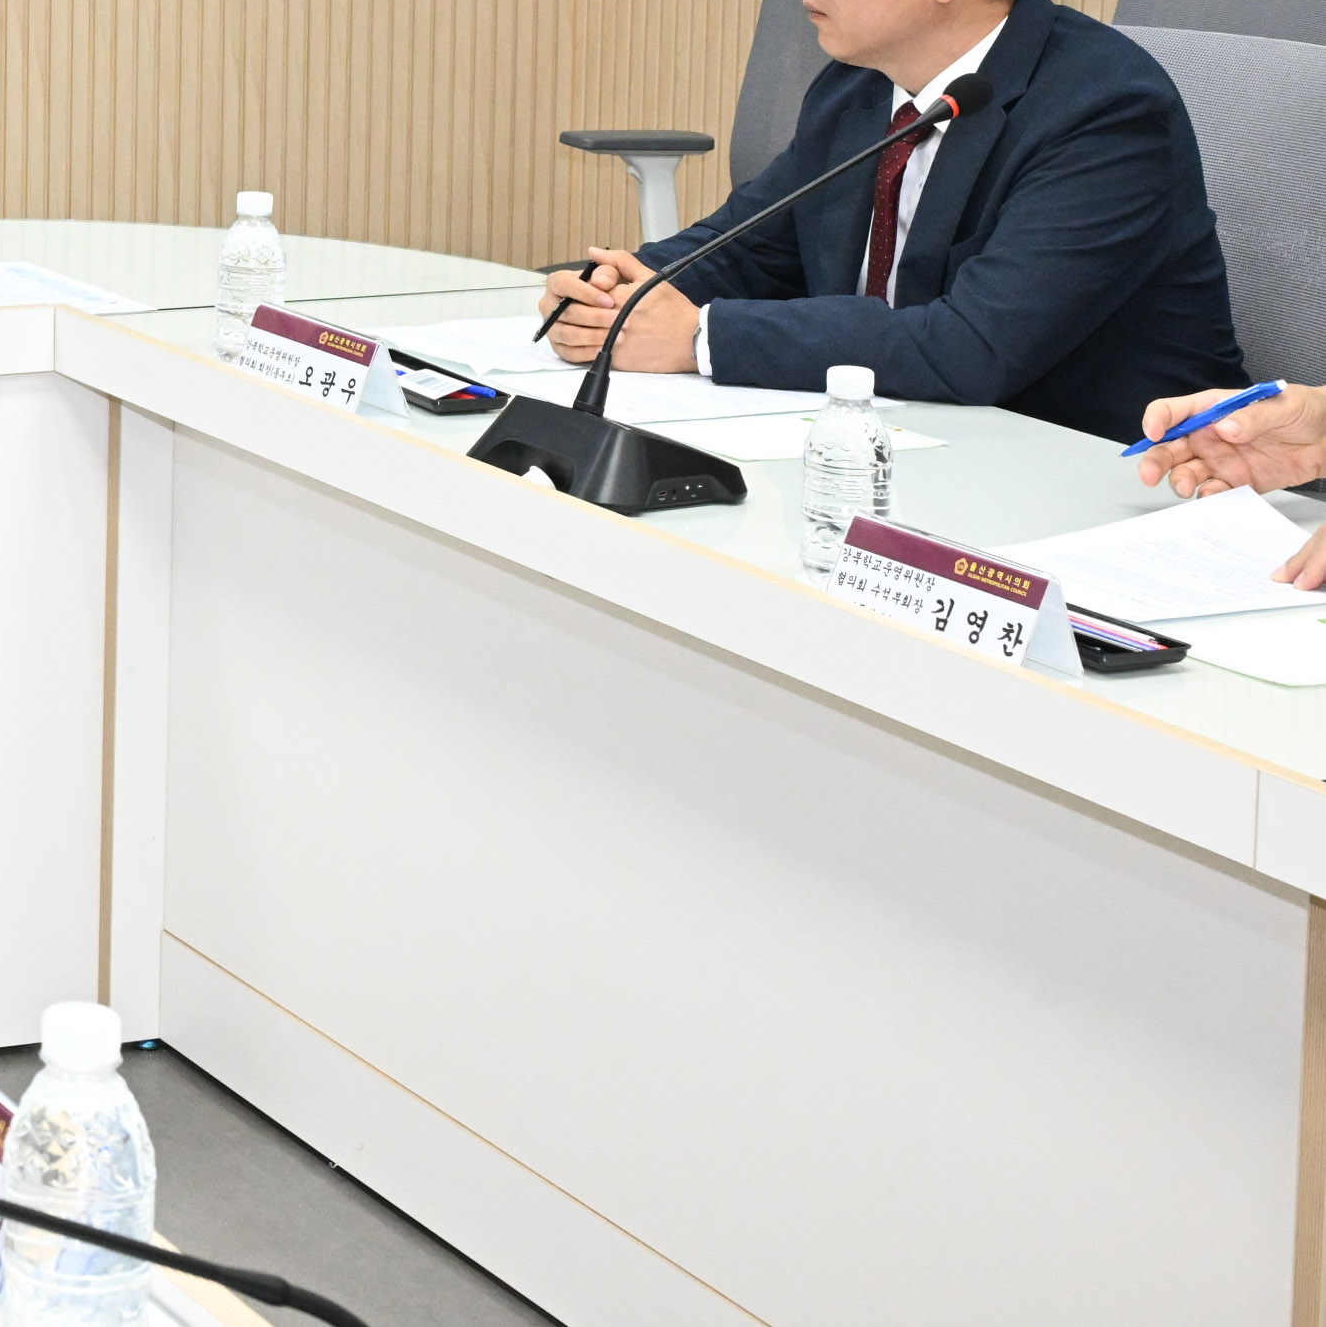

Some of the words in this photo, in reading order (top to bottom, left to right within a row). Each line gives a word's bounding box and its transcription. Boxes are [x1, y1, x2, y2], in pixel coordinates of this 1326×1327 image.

[837, 570, 868, 594] 협의회
[842, 547, 936, 592] 강북학교운영위원장
[969, 562, 1031, 591] 울산광역시의회
